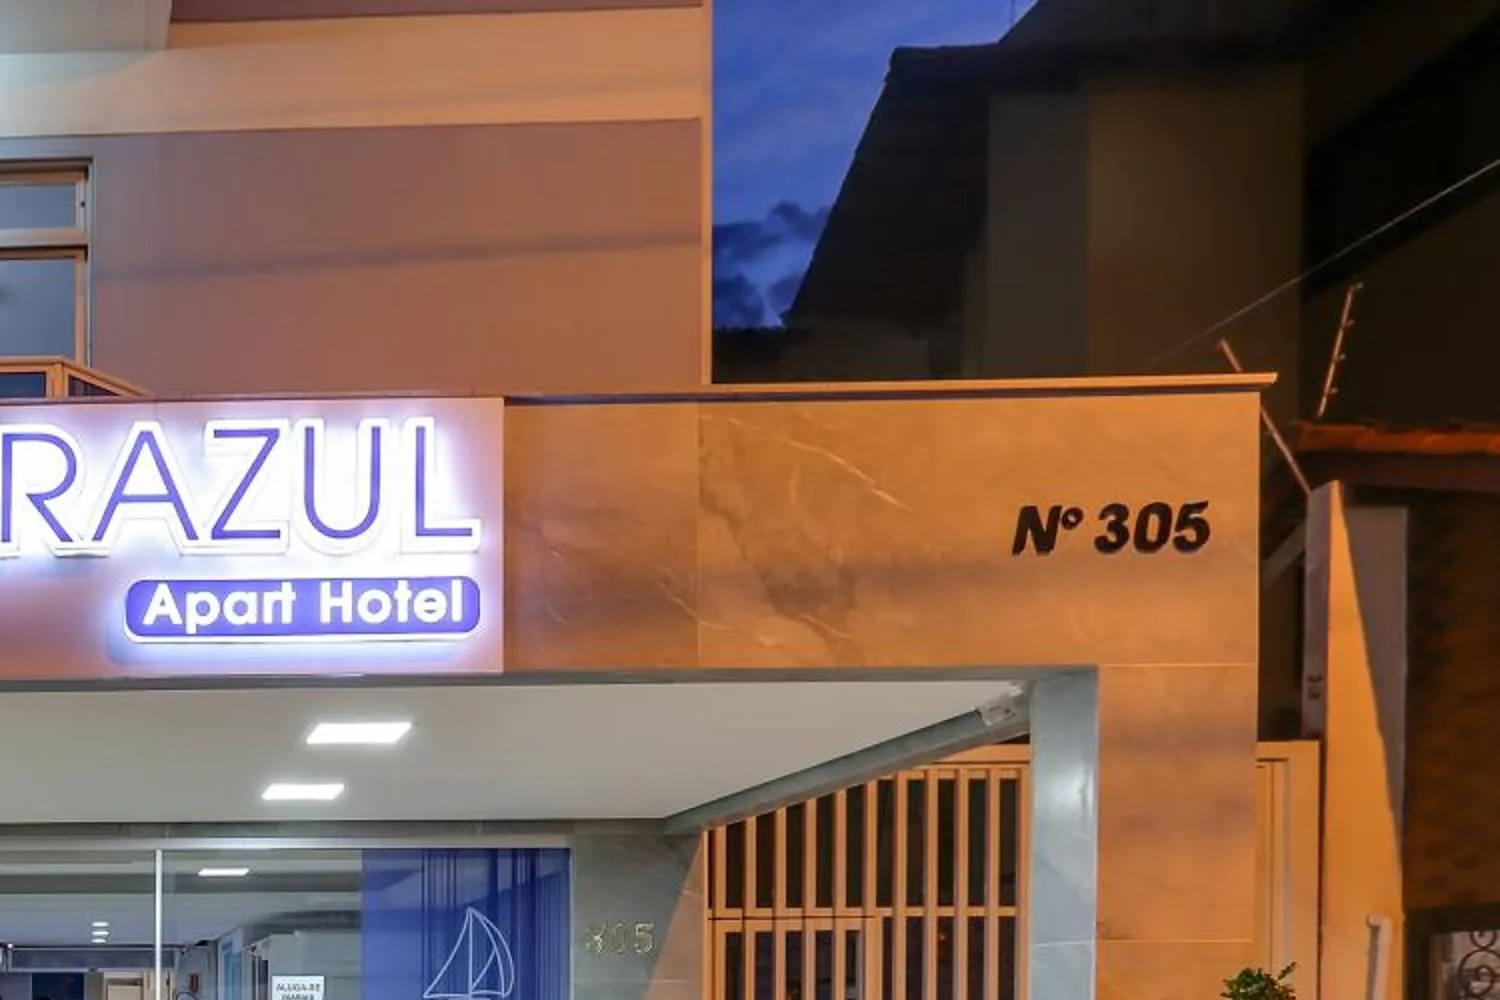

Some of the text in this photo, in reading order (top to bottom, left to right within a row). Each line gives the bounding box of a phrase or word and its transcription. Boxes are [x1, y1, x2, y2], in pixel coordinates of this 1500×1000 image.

[1093, 501, 1211, 554] 305
[142, 579, 463, 634] Apart Hotel
